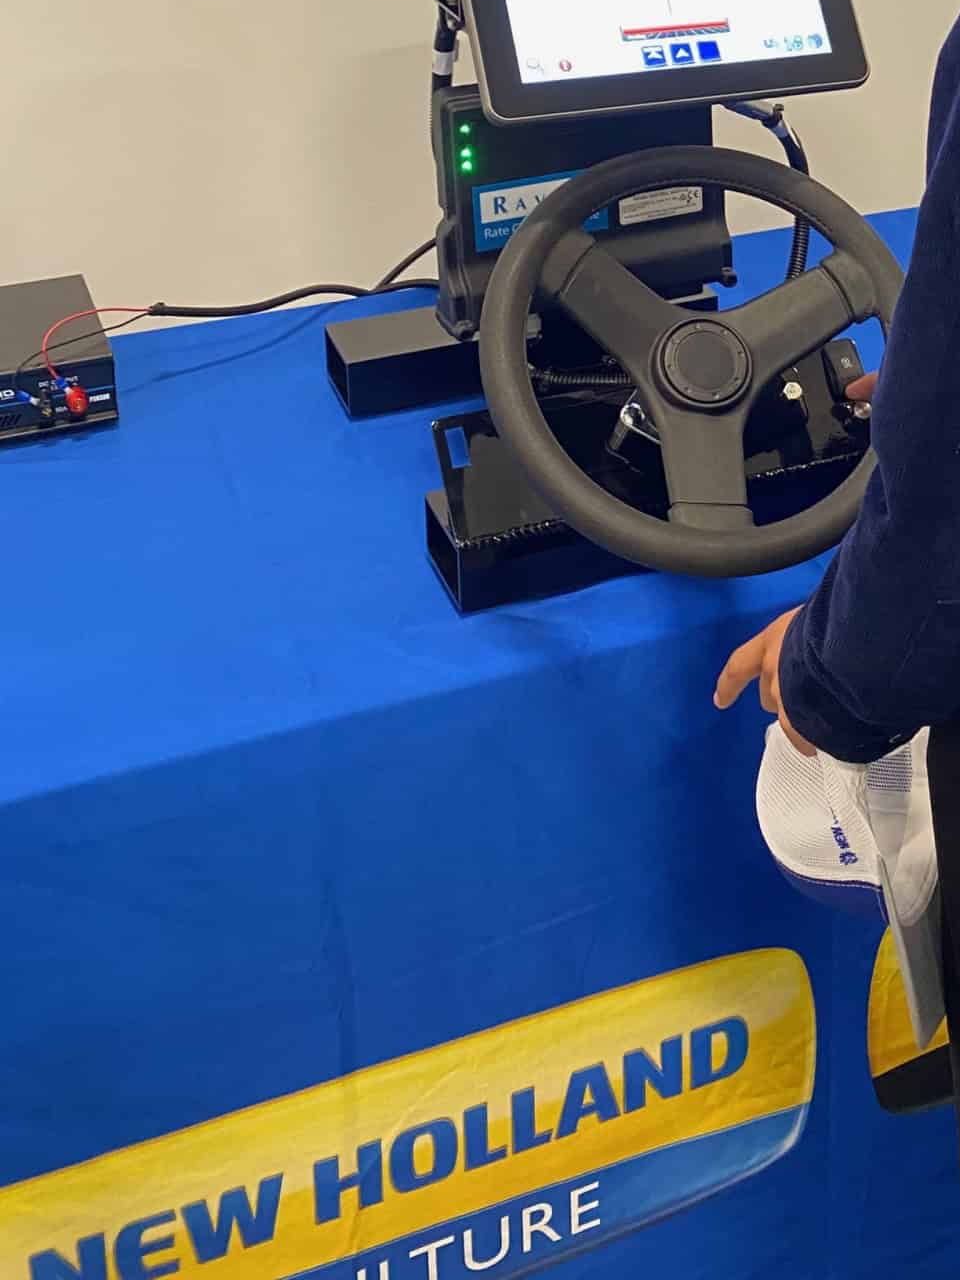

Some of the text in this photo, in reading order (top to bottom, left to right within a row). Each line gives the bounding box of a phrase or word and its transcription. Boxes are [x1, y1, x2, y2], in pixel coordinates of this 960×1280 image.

[483, 226, 510, 241] Rate
[28, 1015, 749, 1280] NEW HOLLAND
